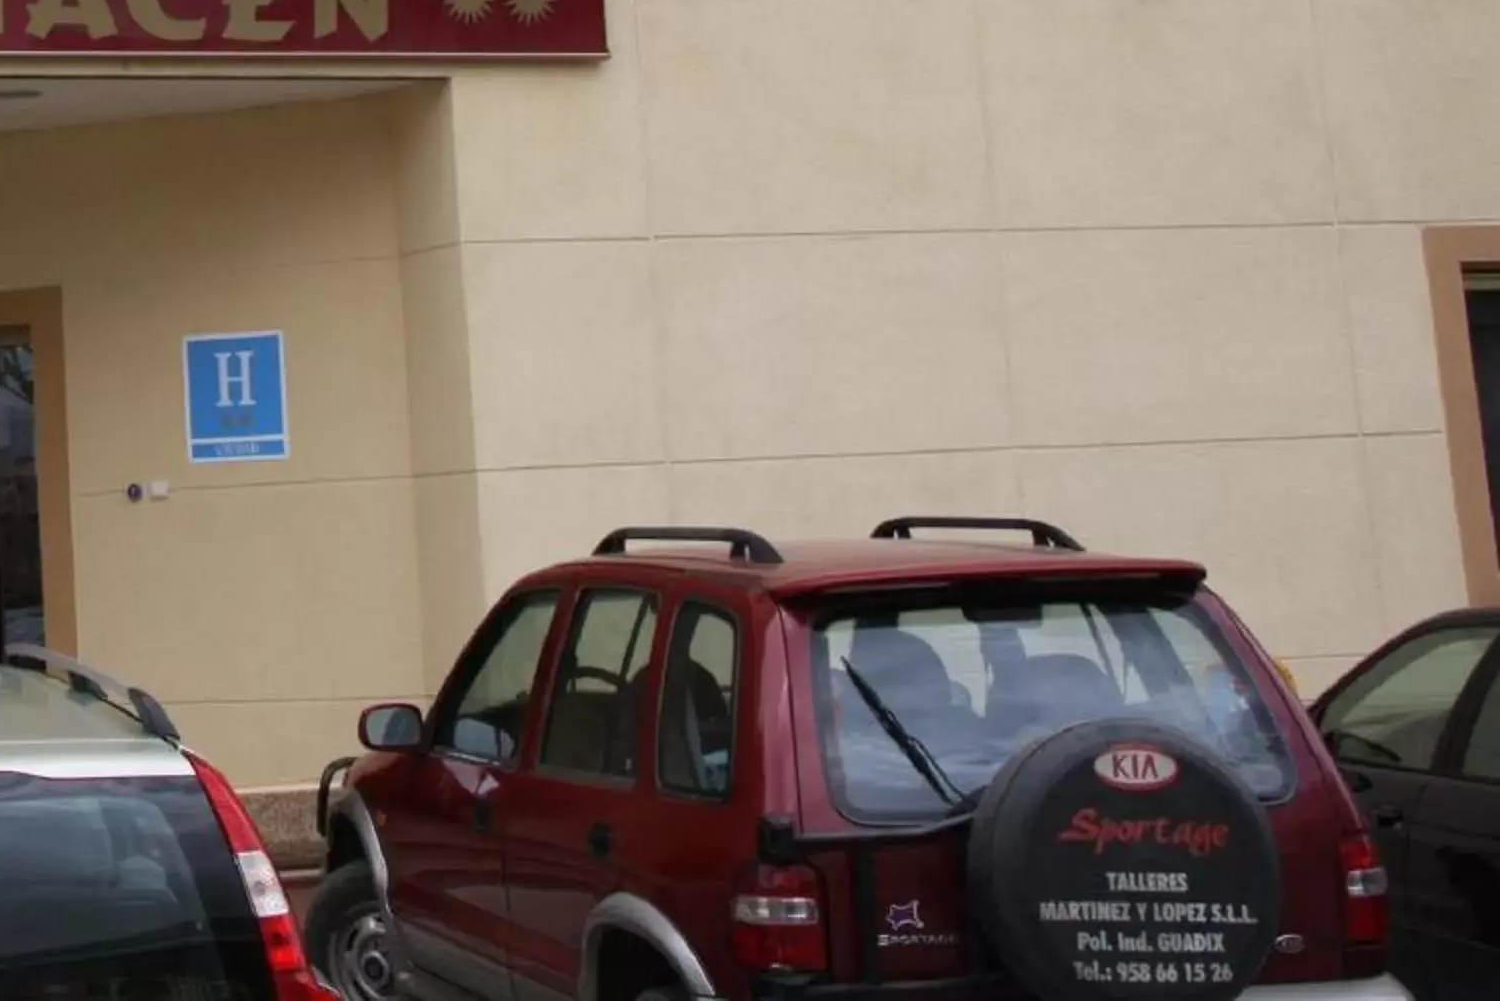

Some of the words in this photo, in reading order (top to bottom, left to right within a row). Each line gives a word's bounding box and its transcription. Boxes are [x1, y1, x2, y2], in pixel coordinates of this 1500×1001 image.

[214, 350, 257, 407] H
[1111, 754, 1159, 779] KIA
[1058, 808, 1229, 855] Sportage
[1105, 872, 1189, 892] TALLERES
[1039, 902, 1132, 921] MARTINEZ
[1136, 903, 1148, 921] Y
[1153, 903, 1207, 922] LOPEZ
[1077, 931, 1113, 951] Pol.
[1117, 932, 1153, 951] Ind.
[1157, 933, 1226, 952] GUADIX
[1116, 962, 1150, 982] 958
[1155, 962, 1178, 982] 66
[1183, 962, 1205, 982] 15
[1209, 962, 1233, 983] 26
